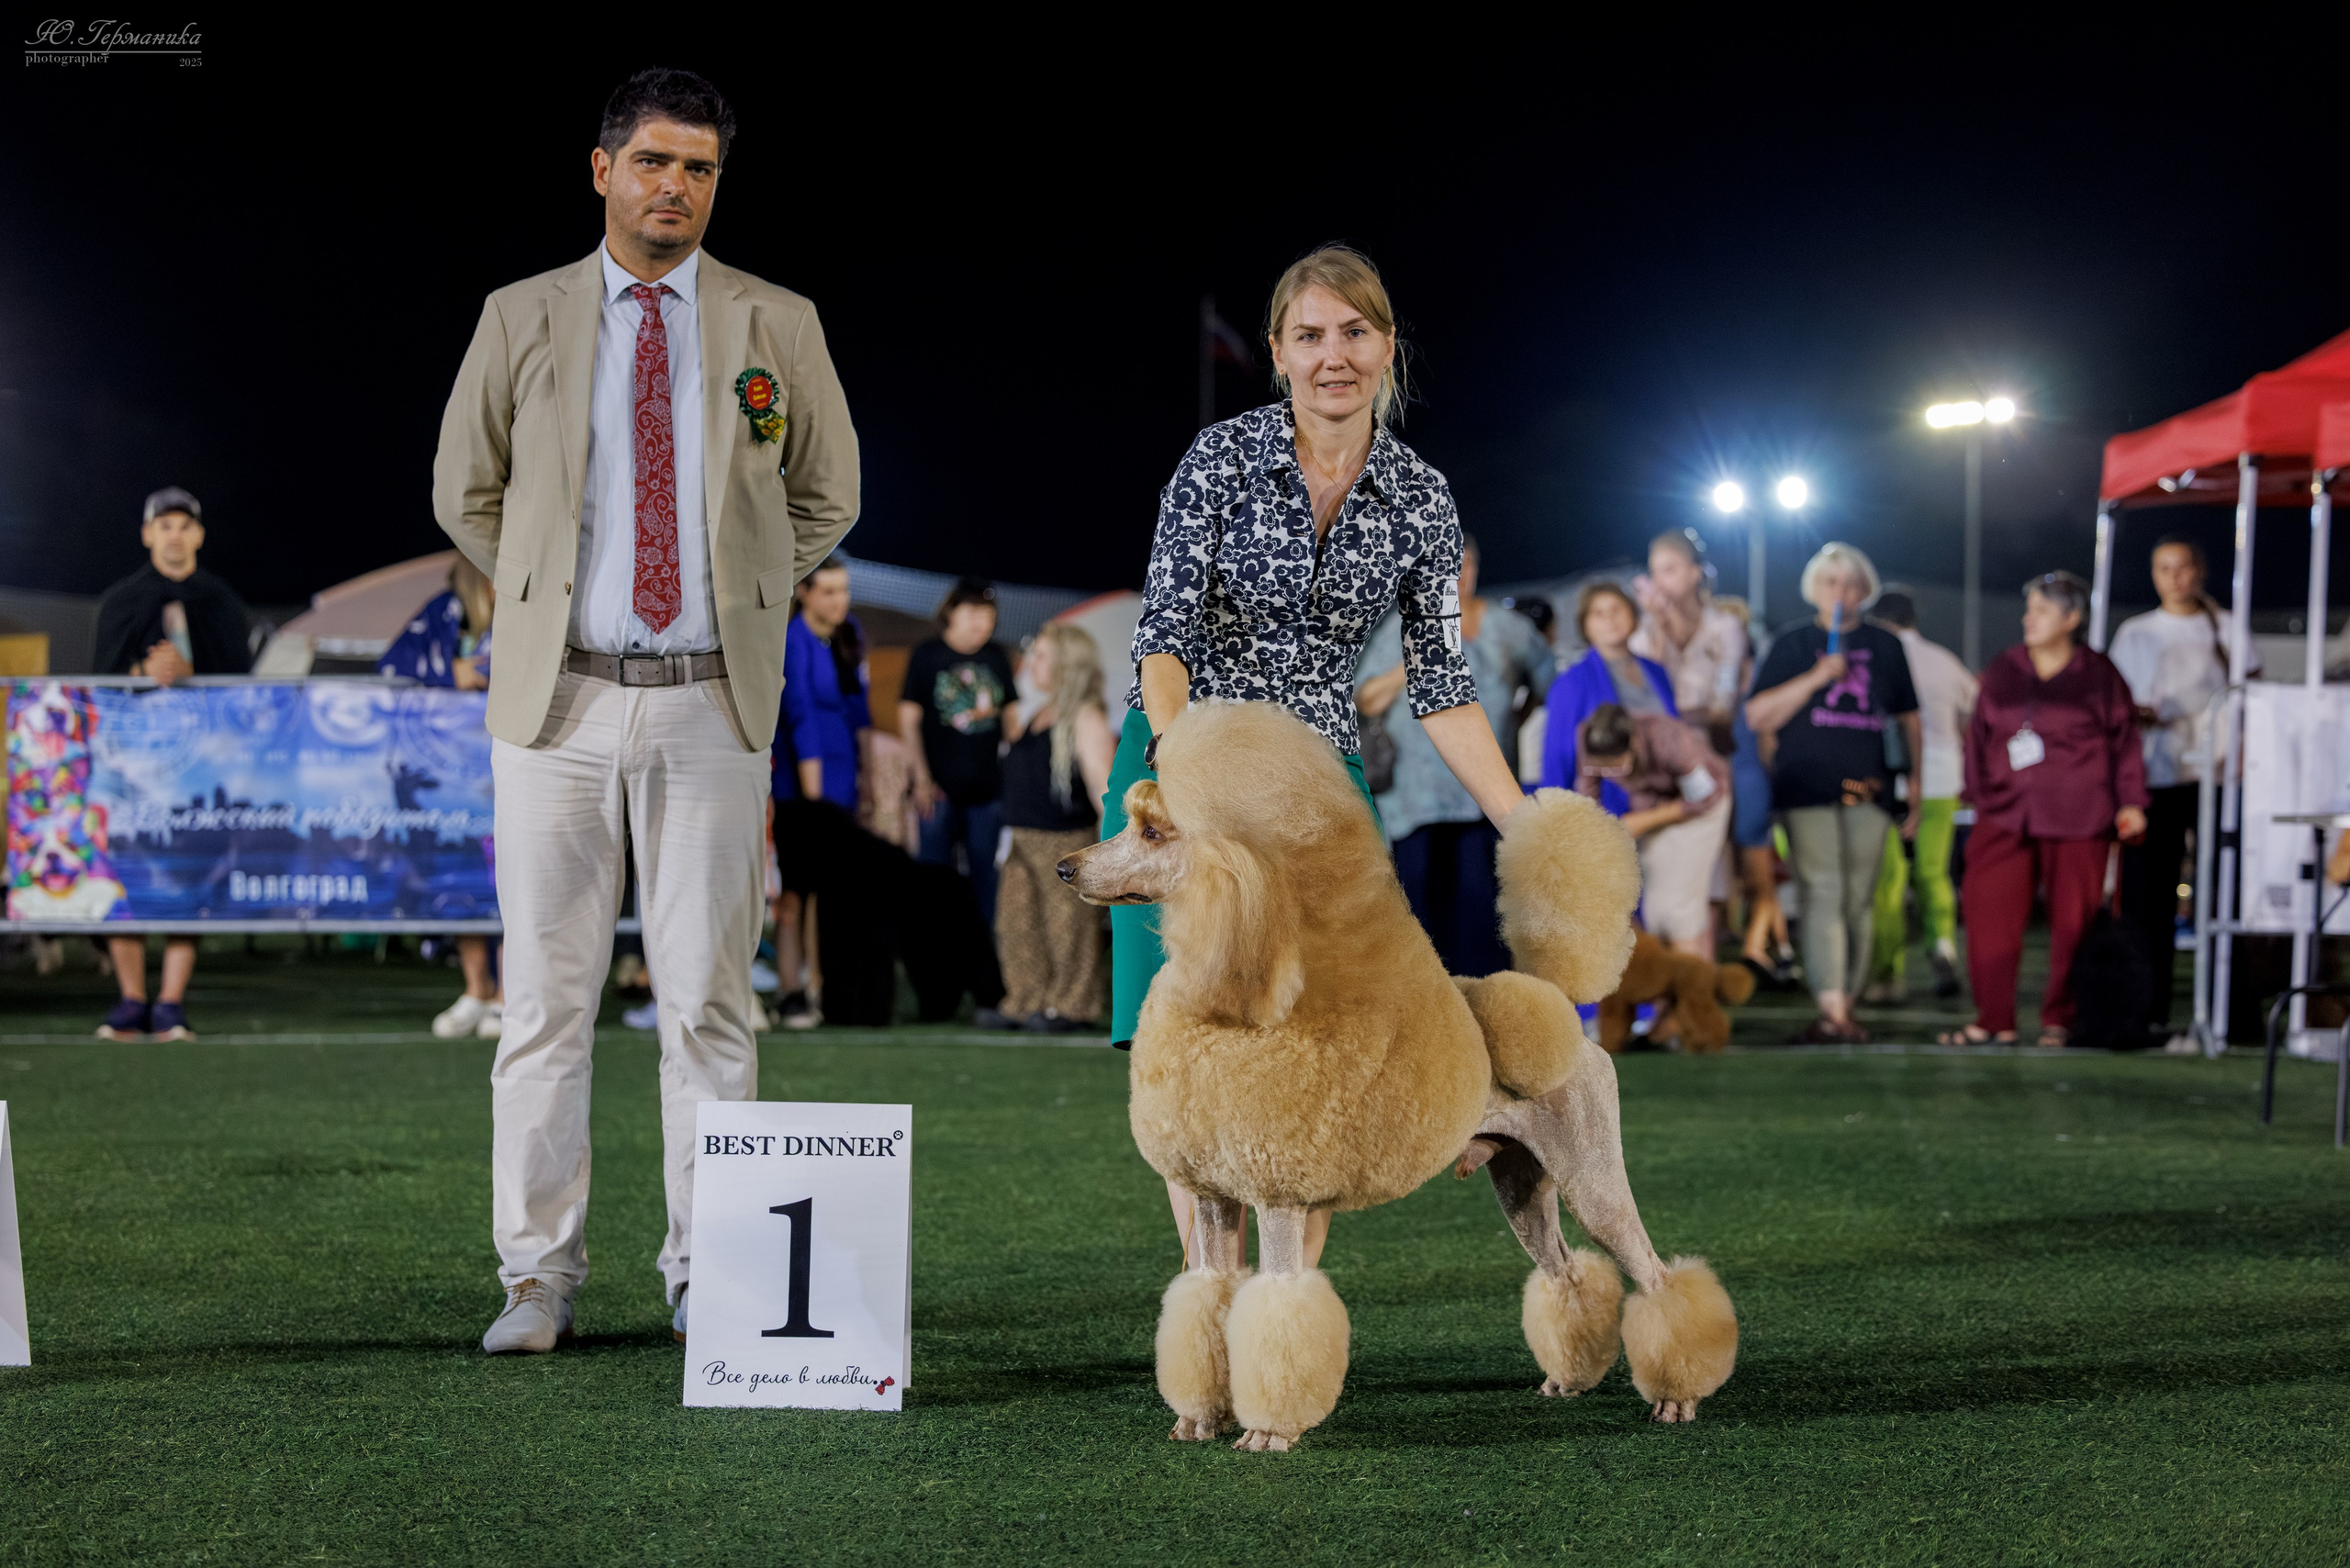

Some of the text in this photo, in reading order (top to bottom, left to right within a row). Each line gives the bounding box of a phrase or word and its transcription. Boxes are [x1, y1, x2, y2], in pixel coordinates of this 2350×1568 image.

[229, 869, 369, 905] Волгоград
[703, 1135, 897, 1157] BEST DINNER
[761, 1196, 834, 1338] 1
[701, 1361, 744, 1385] Все
[748, 1373, 793, 1394] дело
[799, 1365, 811, 1384] в
